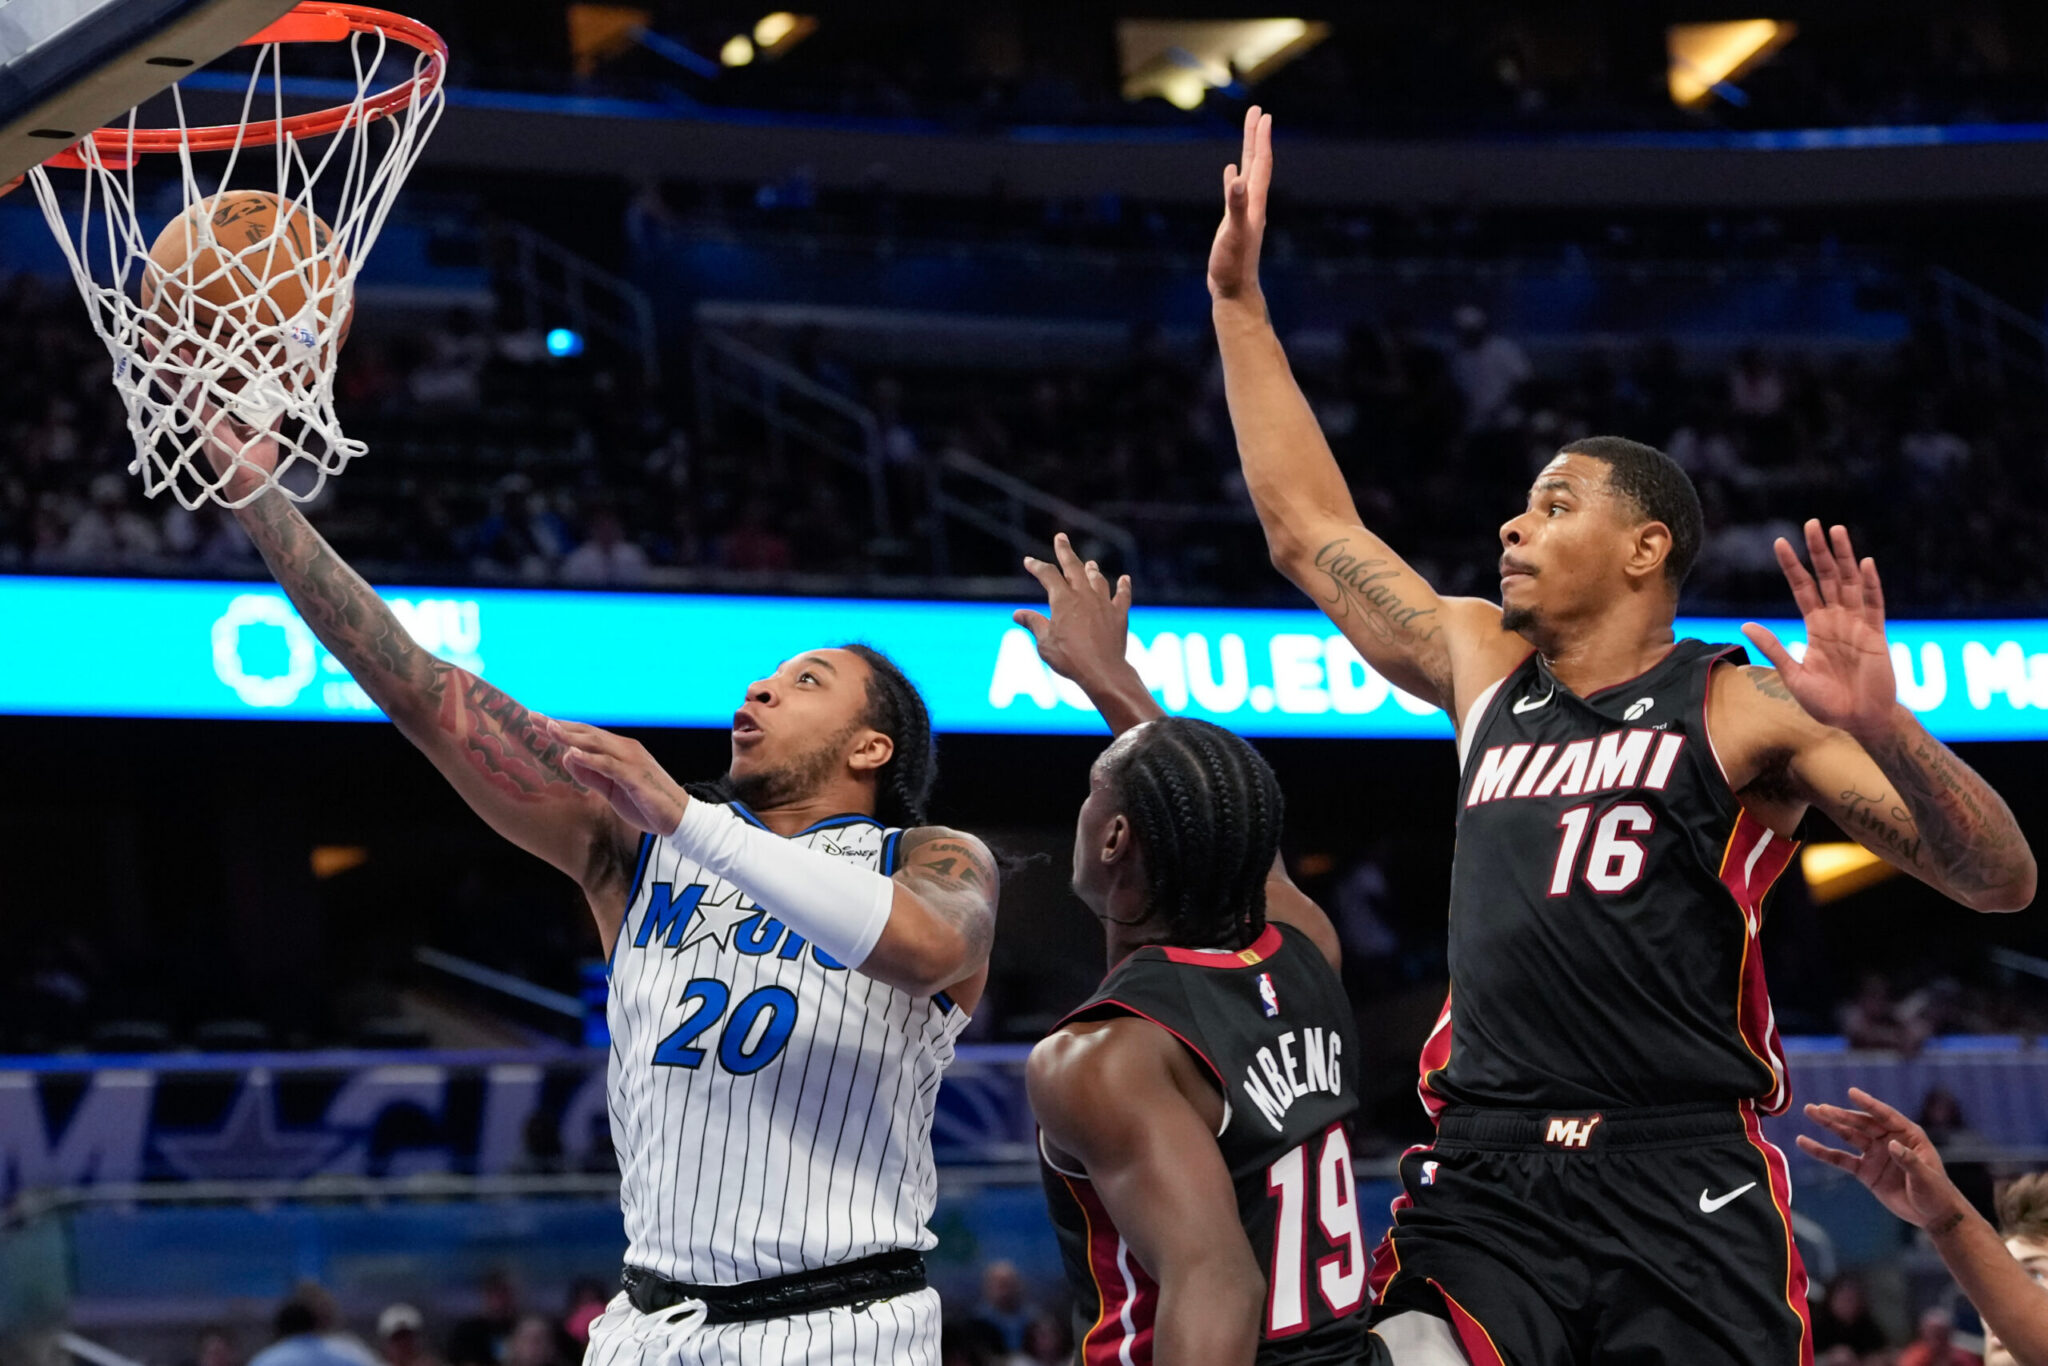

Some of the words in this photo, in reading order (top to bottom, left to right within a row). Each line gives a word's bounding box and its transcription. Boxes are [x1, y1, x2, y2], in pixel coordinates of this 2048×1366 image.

[989, 628, 1444, 716] AMU.ED
[1465, 727, 1686, 809] MIAMI
[1546, 801, 1656, 899] 16
[632, 881, 849, 971] MGI
[650, 977, 798, 1076] 20
[1243, 1027, 1342, 1132] MBENG
[1266, 1120, 1366, 1339] 19
